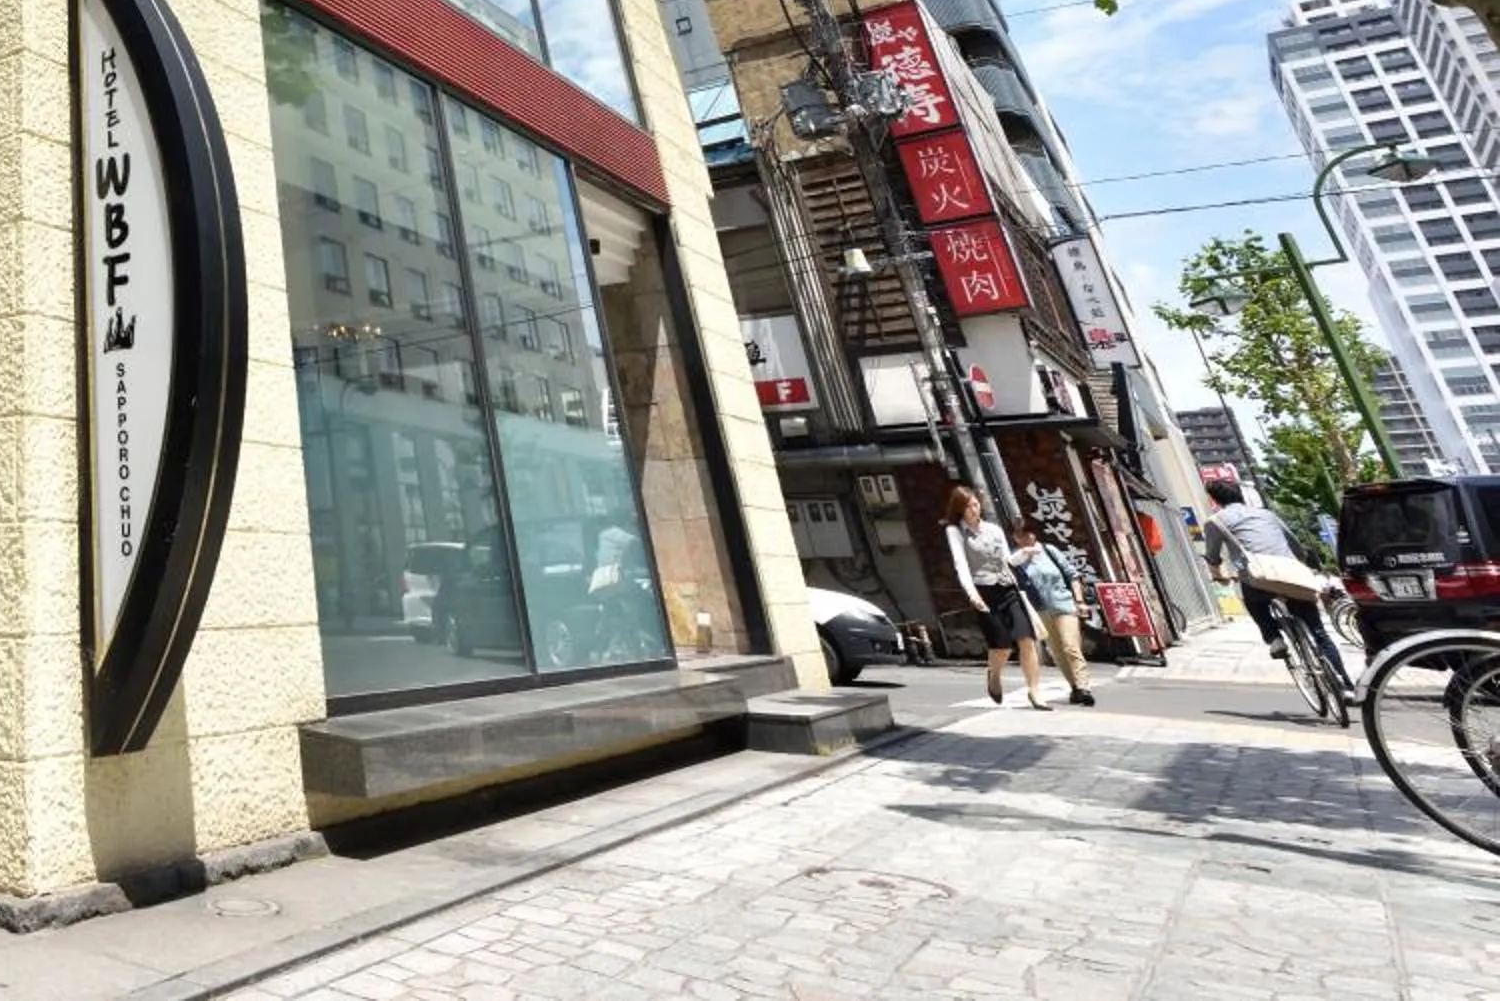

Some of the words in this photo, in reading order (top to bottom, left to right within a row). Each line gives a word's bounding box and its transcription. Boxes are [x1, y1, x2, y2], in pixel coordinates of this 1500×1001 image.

[101, 46, 120, 148] HOTEL
[917, 146, 971, 215] 炭火
[96, 152, 131, 307] WBF
[947, 229, 1000, 304] 焼肉
[116, 362, 130, 480] SAPPORO
[119, 486, 133, 557] CHUO
